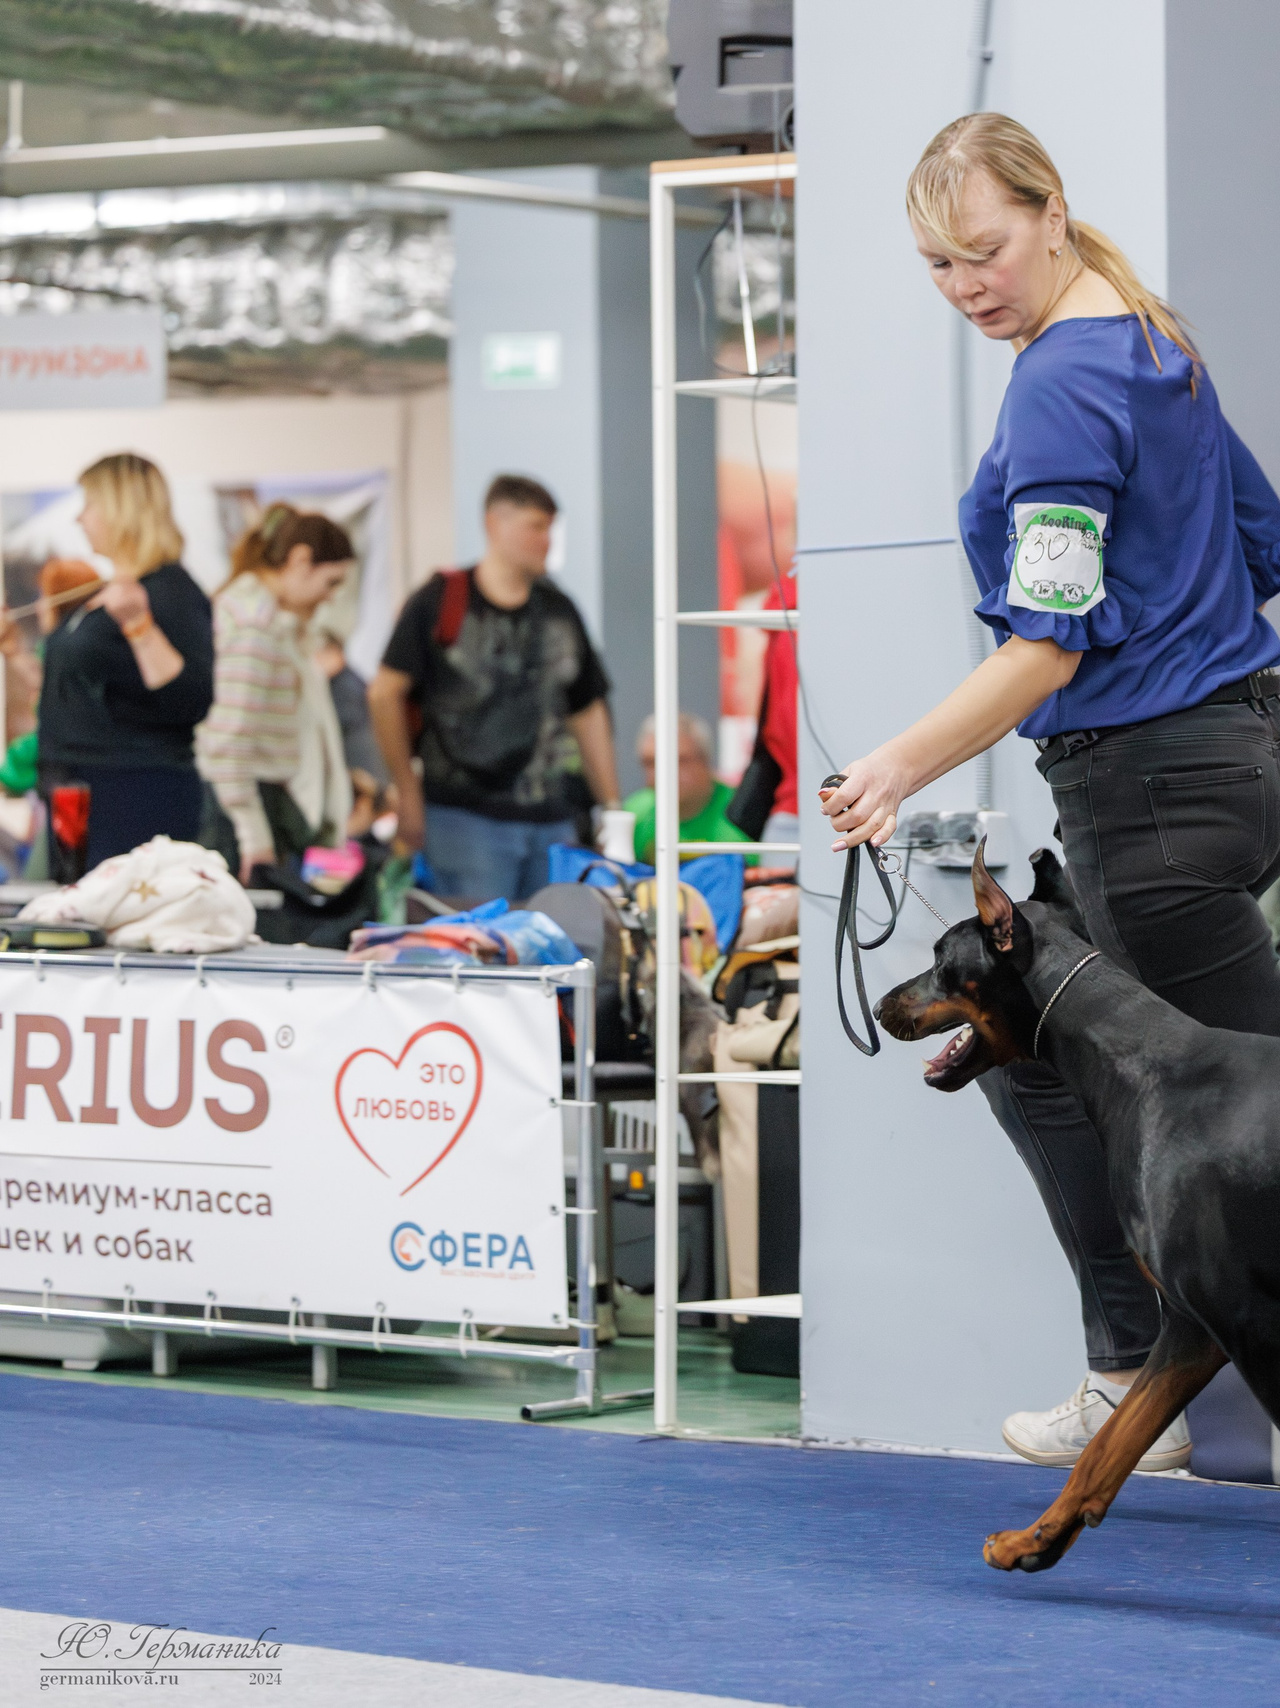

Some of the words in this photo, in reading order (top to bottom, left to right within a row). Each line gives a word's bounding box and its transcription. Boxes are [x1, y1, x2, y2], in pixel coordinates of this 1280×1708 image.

[1025, 531, 1070, 565] 30
[419, 1062, 465, 1085] ЭТО
[353, 1098, 456, 1121] ЛЮБОВЬ
[0, 1177, 273, 1216] ремиум-класса
[63, 1231, 83, 1255] и
[94, 1228, 195, 1264] собак
[390, 1221, 535, 1272] СФЕРА
